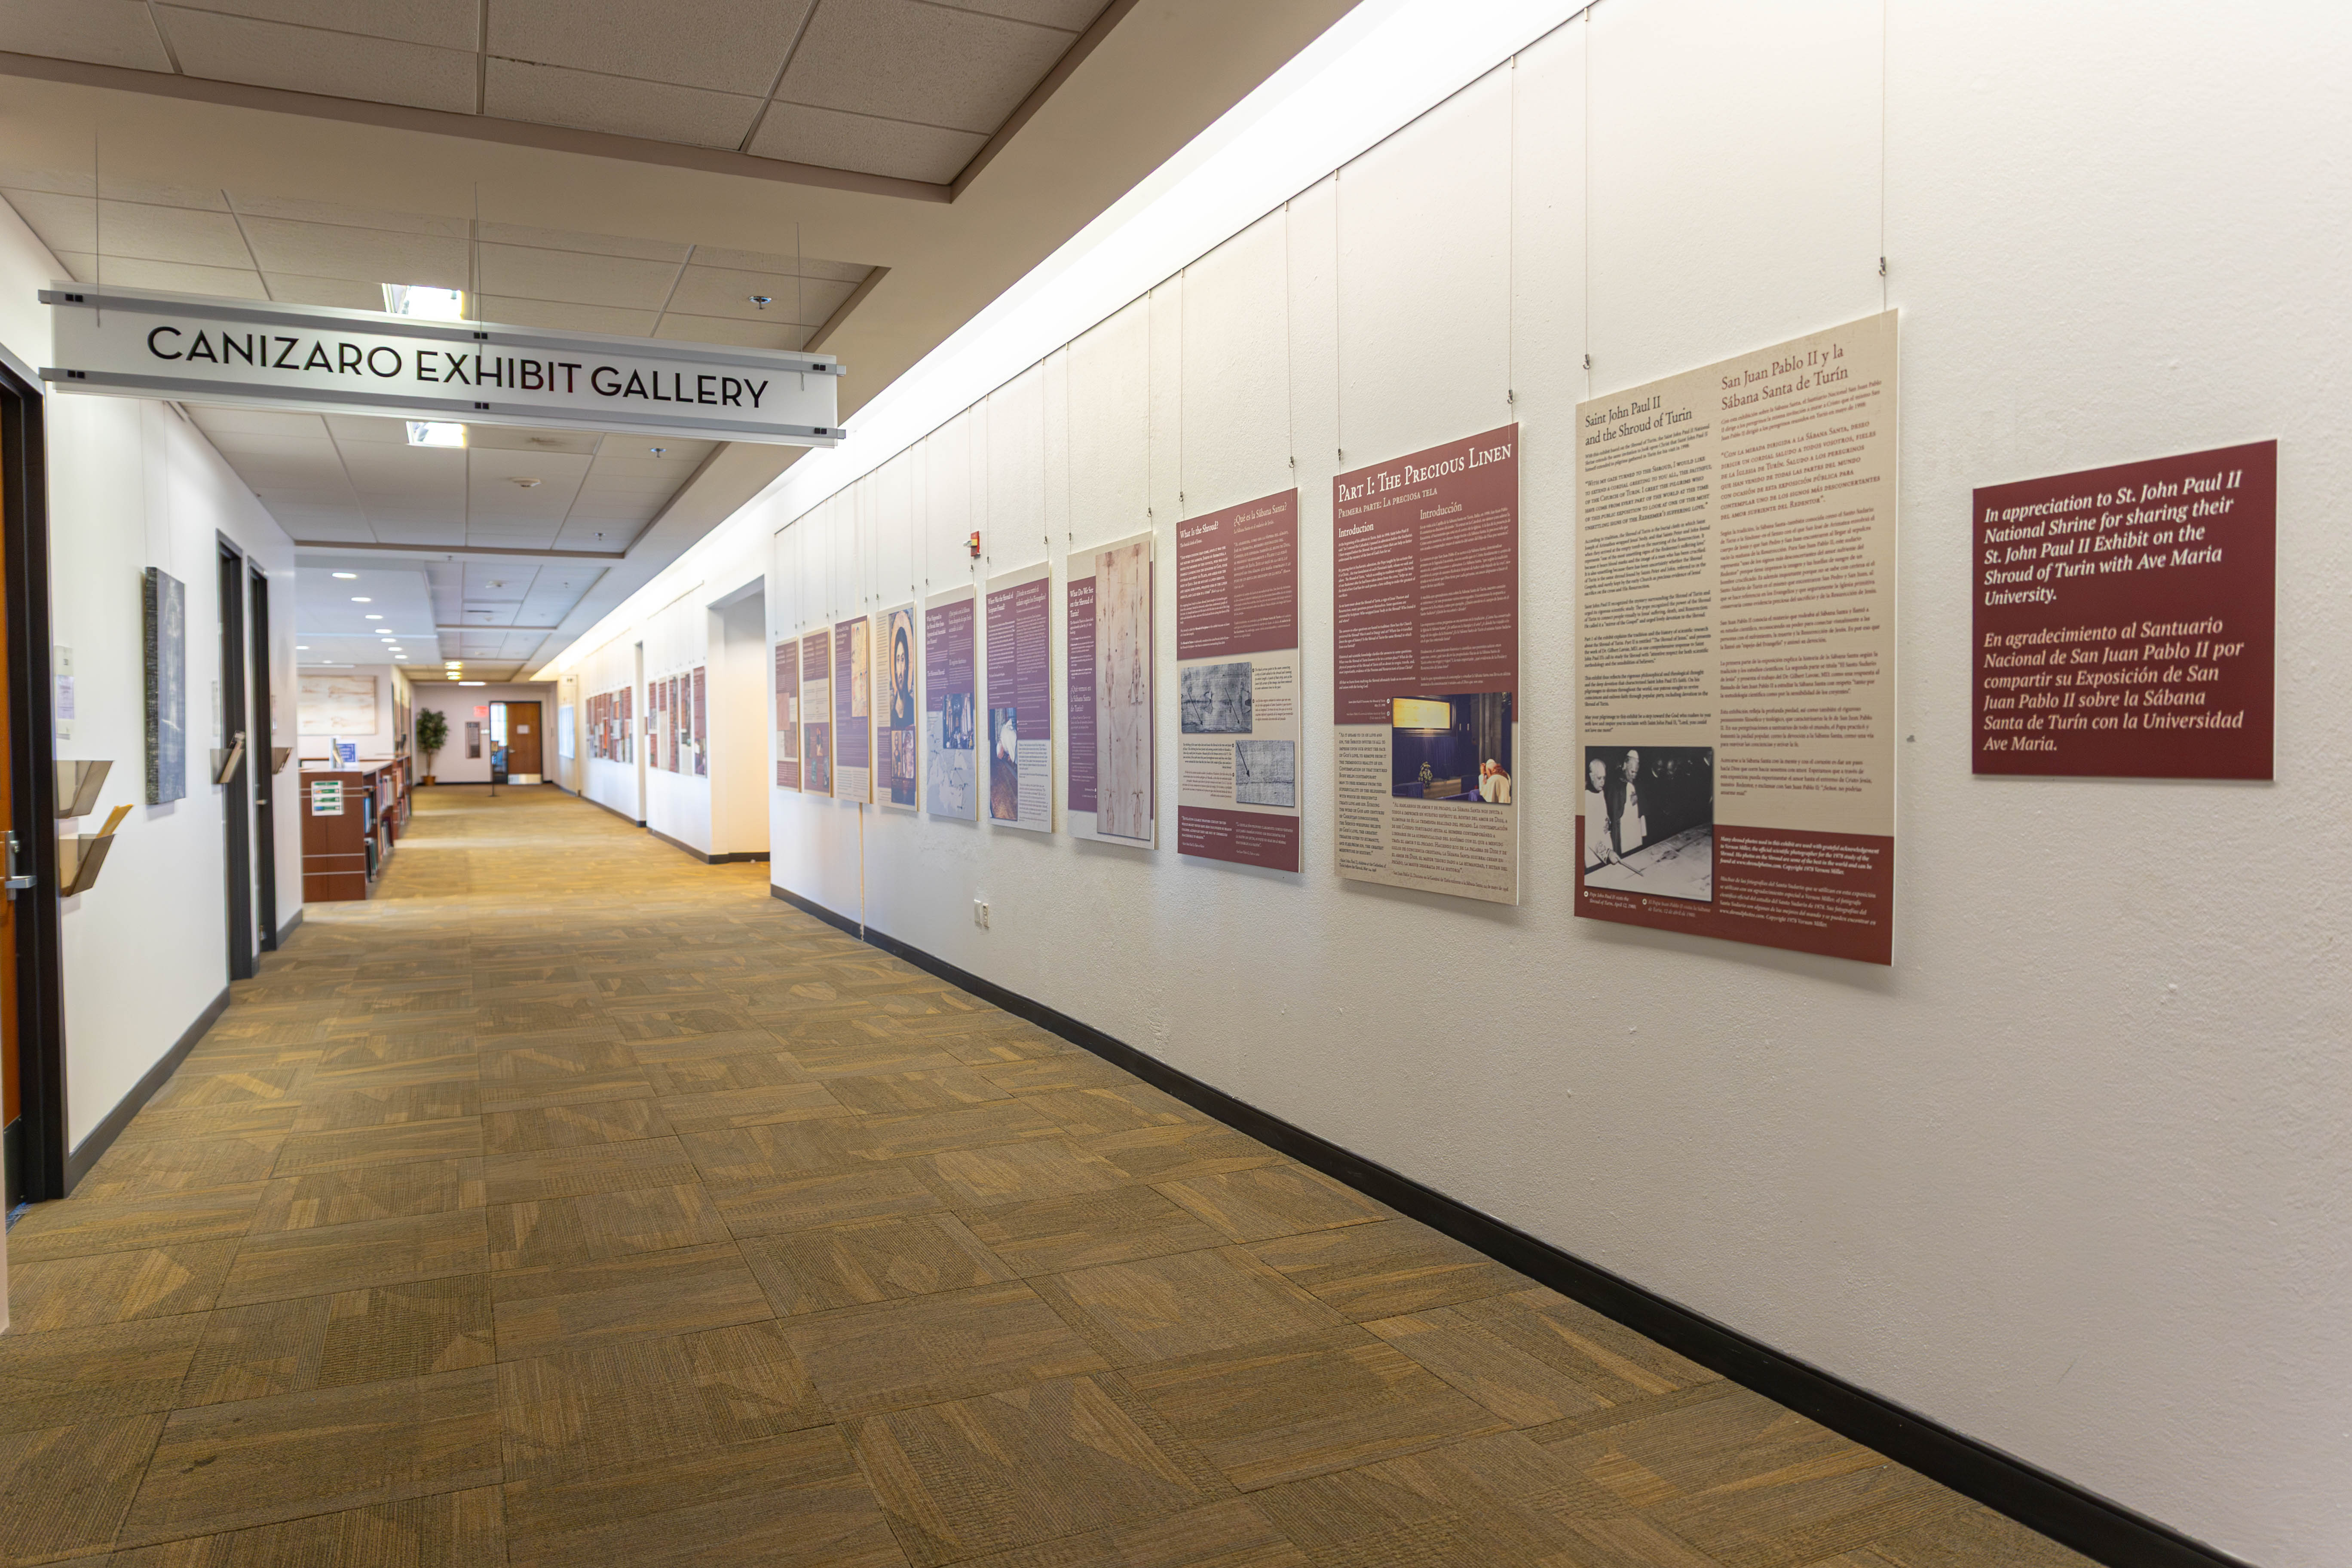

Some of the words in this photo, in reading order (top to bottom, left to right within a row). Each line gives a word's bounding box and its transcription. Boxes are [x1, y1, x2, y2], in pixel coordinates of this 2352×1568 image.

[147, 326, 402, 377] CANIZARO
[416, 344, 582, 393] EXHIBIT
[591, 366, 769, 408] GALLERY
[1721, 376, 1740, 390] San
[1744, 370, 1768, 387] Juan
[1772, 355, 1803, 376] Pablo
[1807, 350, 1818, 366] II
[1822, 352, 1829, 367] y
[1833, 343, 1844, 359] la
[1721, 393, 1759, 410] Sábana
[1762, 384, 1793, 400] Santa
[1796, 375, 1810, 391] de
[1813, 366, 1848, 386] Turín
[1585, 413, 1606, 427] Saint
[1609, 406, 1629, 424] John
[1631, 398, 1650, 415] Paul
[1653, 395, 1660, 409] II
[1585, 430, 1601, 446] and
[1603, 428, 1617, 441] the
[1619, 416, 1651, 437] Shroud
[1654, 412, 1664, 428] of
[1665, 407, 1692, 425] Turin
[1367, 477, 1375, 495] I:
[1984, 508, 1998, 523] In
[2002, 495, 2092, 522] appreciation
[2097, 493, 2112, 507] to
[2116, 487, 2135, 504] St.
[2140, 481, 2177, 503] John
[2182, 472, 2222, 495] Paul
[2226, 469, 2242, 488] II
[1420, 502, 1462, 520] Introducción
[1984, 521, 2045, 544] National
[2049, 516, 2096, 535] Shrine
[2099, 512, 2123, 532] for
[2125, 504, 2189, 525] sharing
[2192, 496, 2234, 517] their
[1338, 522, 1374, 538] Introduction
[1984, 550, 2001, 564] St.
[2005, 545, 2037, 564] John
[2040, 539, 2074, 558] Paul
[2077, 537, 2090, 554] II
[2093, 530, 2149, 552] Exhibit
[2153, 531, 2173, 545] on
[2178, 524, 2205, 542] the
[1984, 565, 2034, 585] Shroud
[2037, 563, 2053, 582] of
[2055, 560, 2095, 578] Turin
[2099, 554, 2132, 573] with
[2136, 554, 2166, 570] Ave
[2170, 545, 2222, 566] Maria
[1985, 586, 2057, 606] University.
[1984, 633, 2002, 647] En
[2006, 626, 2117, 649] agradecimiento
[2121, 622, 2137, 639] al
[2141, 616, 2223, 637] Santuario
[1983, 650, 2046, 668] Nacional
[2049, 649, 2067, 665] de
[2070, 649, 2098, 664] San
[2102, 647, 2138, 664] Juan
[2142, 642, 2190, 660] Pablo
[2195, 641, 2209, 658] II
[2212, 642, 2244, 661] por
[1984, 672, 2052, 691] compartir
[2055, 674, 2072, 686] su
[2076, 666, 2158, 688] Exposición
[2163, 665, 2182, 683] de
[2187, 665, 2219, 682] San
[1983, 695, 2015, 711] Juan
[2018, 692, 2059, 708] Pablo
[2063, 692, 2075, 707] II
[2078, 691, 2119, 707] sobre
[2124, 690, 2138, 706] la
[2143, 689, 2205, 706] Sábana
[1984, 716, 2023, 730] Santa
[2027, 714, 2044, 729] de
[2048, 713, 2087, 729] Turín
[2092, 717, 2118, 729] con
[2123, 712, 2138, 729] la
[2143, 710, 2244, 729] Universidad
[1983, 737, 2008, 750] Ave
[2011, 735, 2057, 751] Maria.
